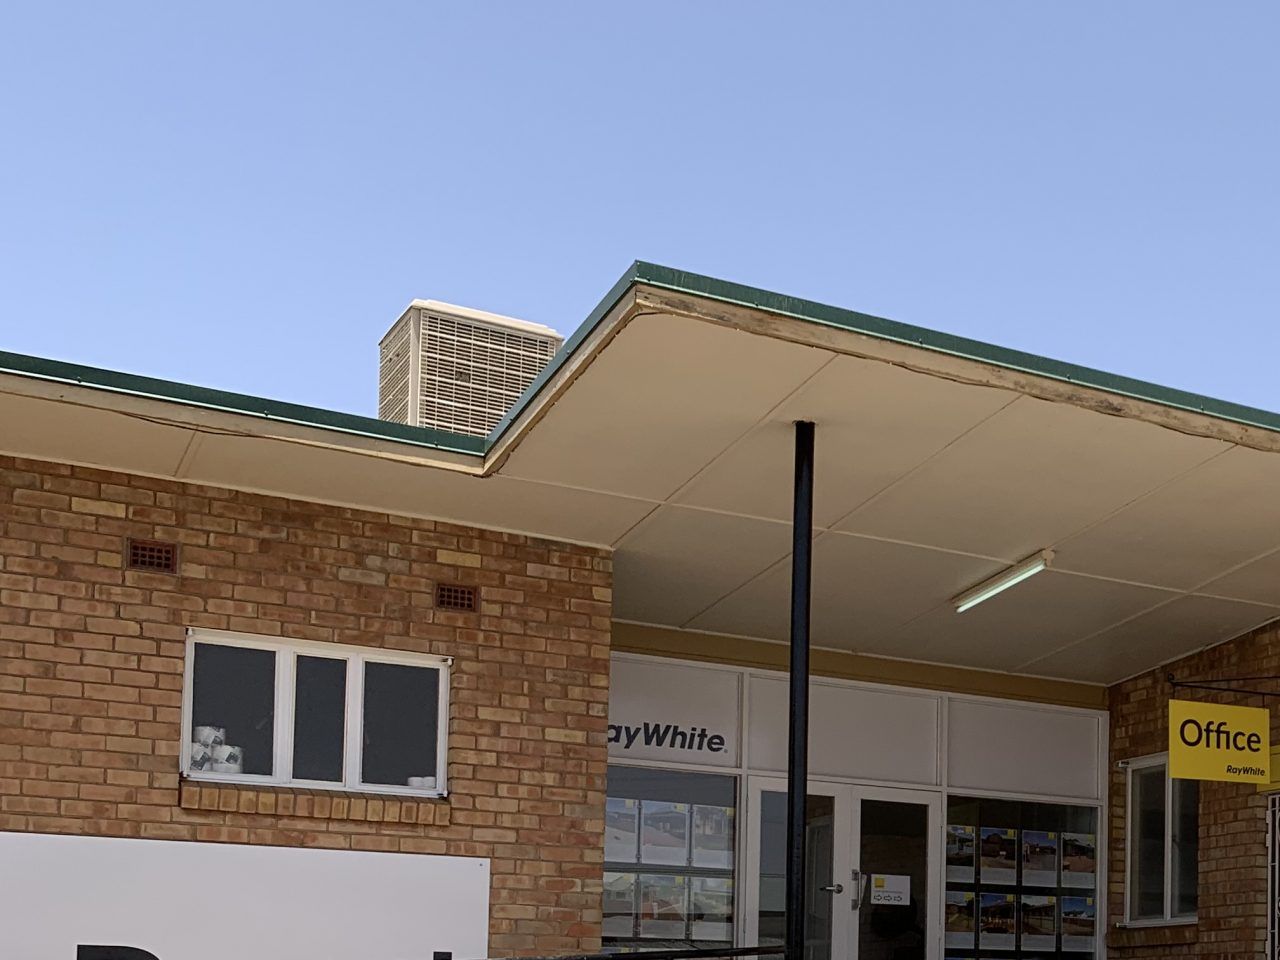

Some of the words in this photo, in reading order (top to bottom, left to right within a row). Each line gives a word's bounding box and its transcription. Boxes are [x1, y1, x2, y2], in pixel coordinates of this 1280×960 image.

[608, 722, 725, 753] ayWhite
[1179, 719, 1261, 753] Office
[1226, 764, 1266, 777] RayWhite
